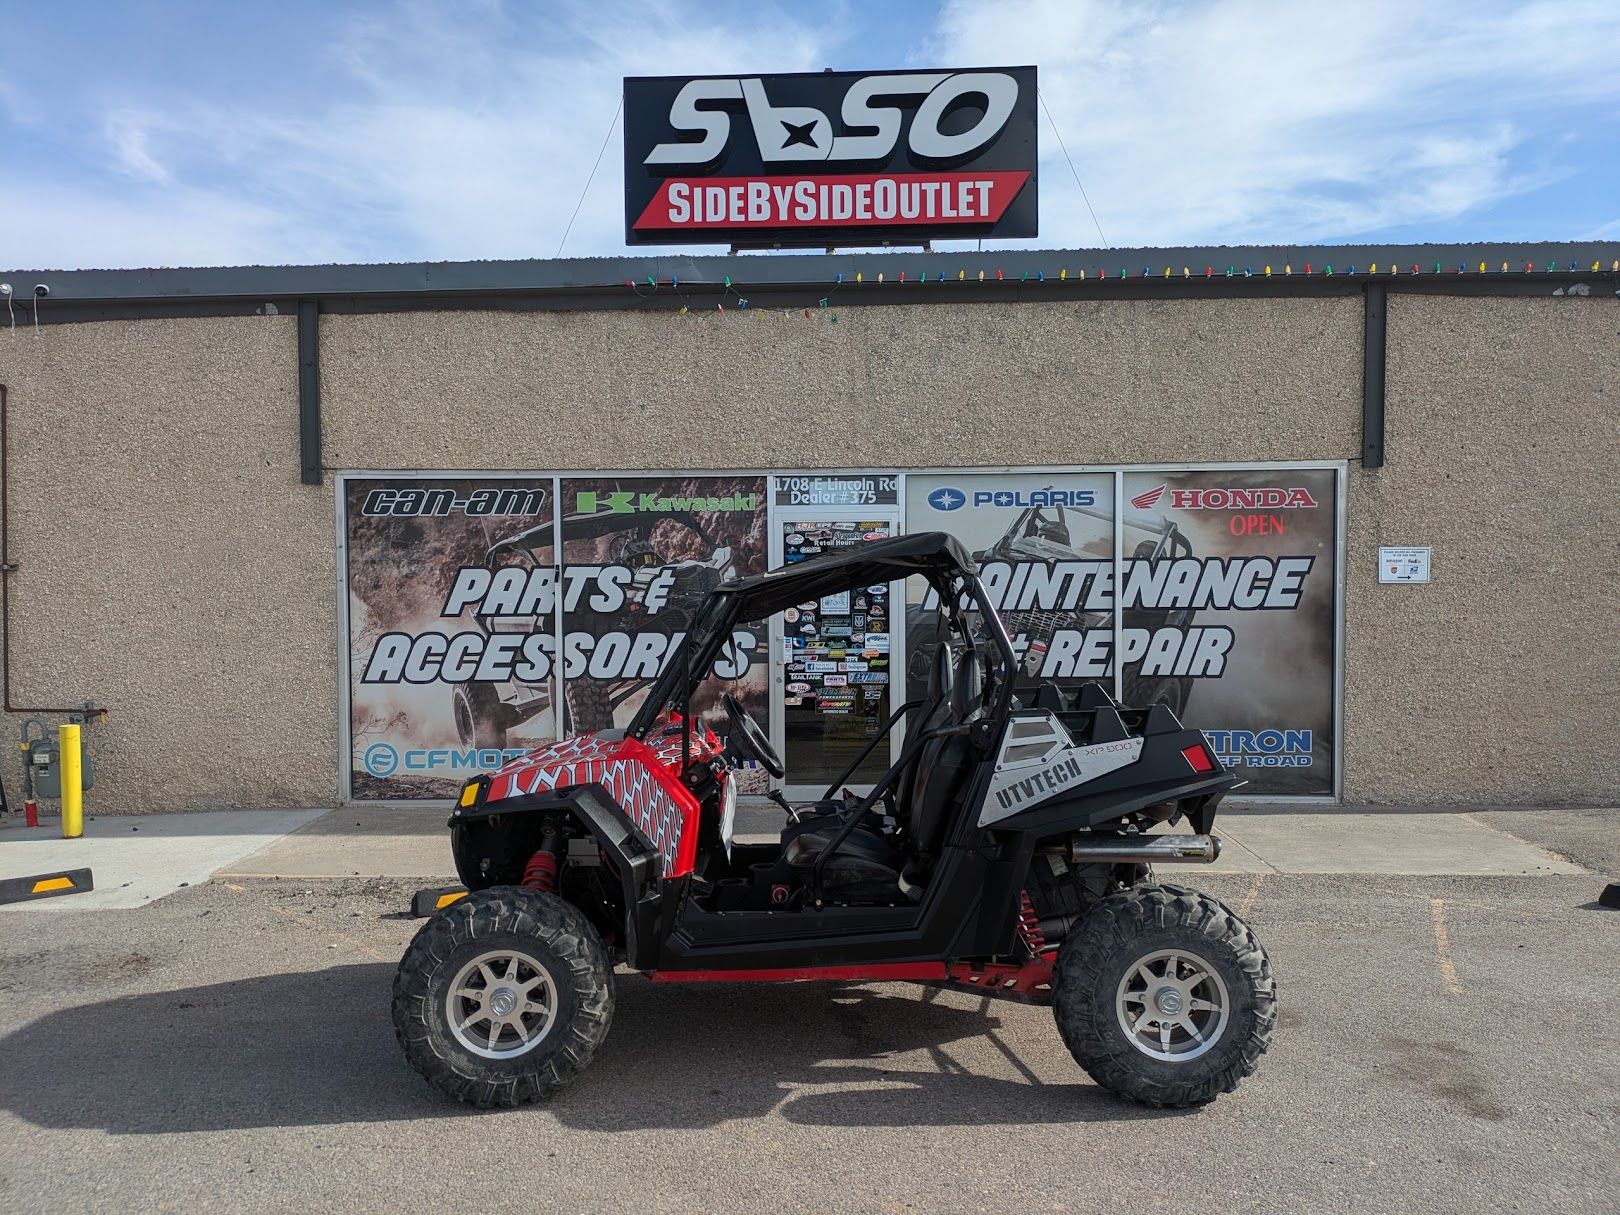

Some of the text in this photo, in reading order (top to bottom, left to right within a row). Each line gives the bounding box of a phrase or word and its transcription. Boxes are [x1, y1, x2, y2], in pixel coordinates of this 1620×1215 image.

[775, 478, 810, 491] 1708
[814, 478, 823, 491] E
[827, 478, 875, 491] Lincoln
[639, 492, 757, 512] Kawasaki
[790, 491, 877, 504] Dealer #375
[974, 490, 1095, 508] POLARIS
[1171, 488, 1318, 509] HONDA
[1230, 515, 1284, 536] OPEN
[443, 567, 634, 616] PARTS
[362, 631, 759, 683] ACCESSORIS
[1038, 626, 1233, 679] REPAIR
[1202, 729, 1313, 753] TRON
[404, 748, 533, 771] CFMOT
[1245, 755, 1313, 768] ROAD
